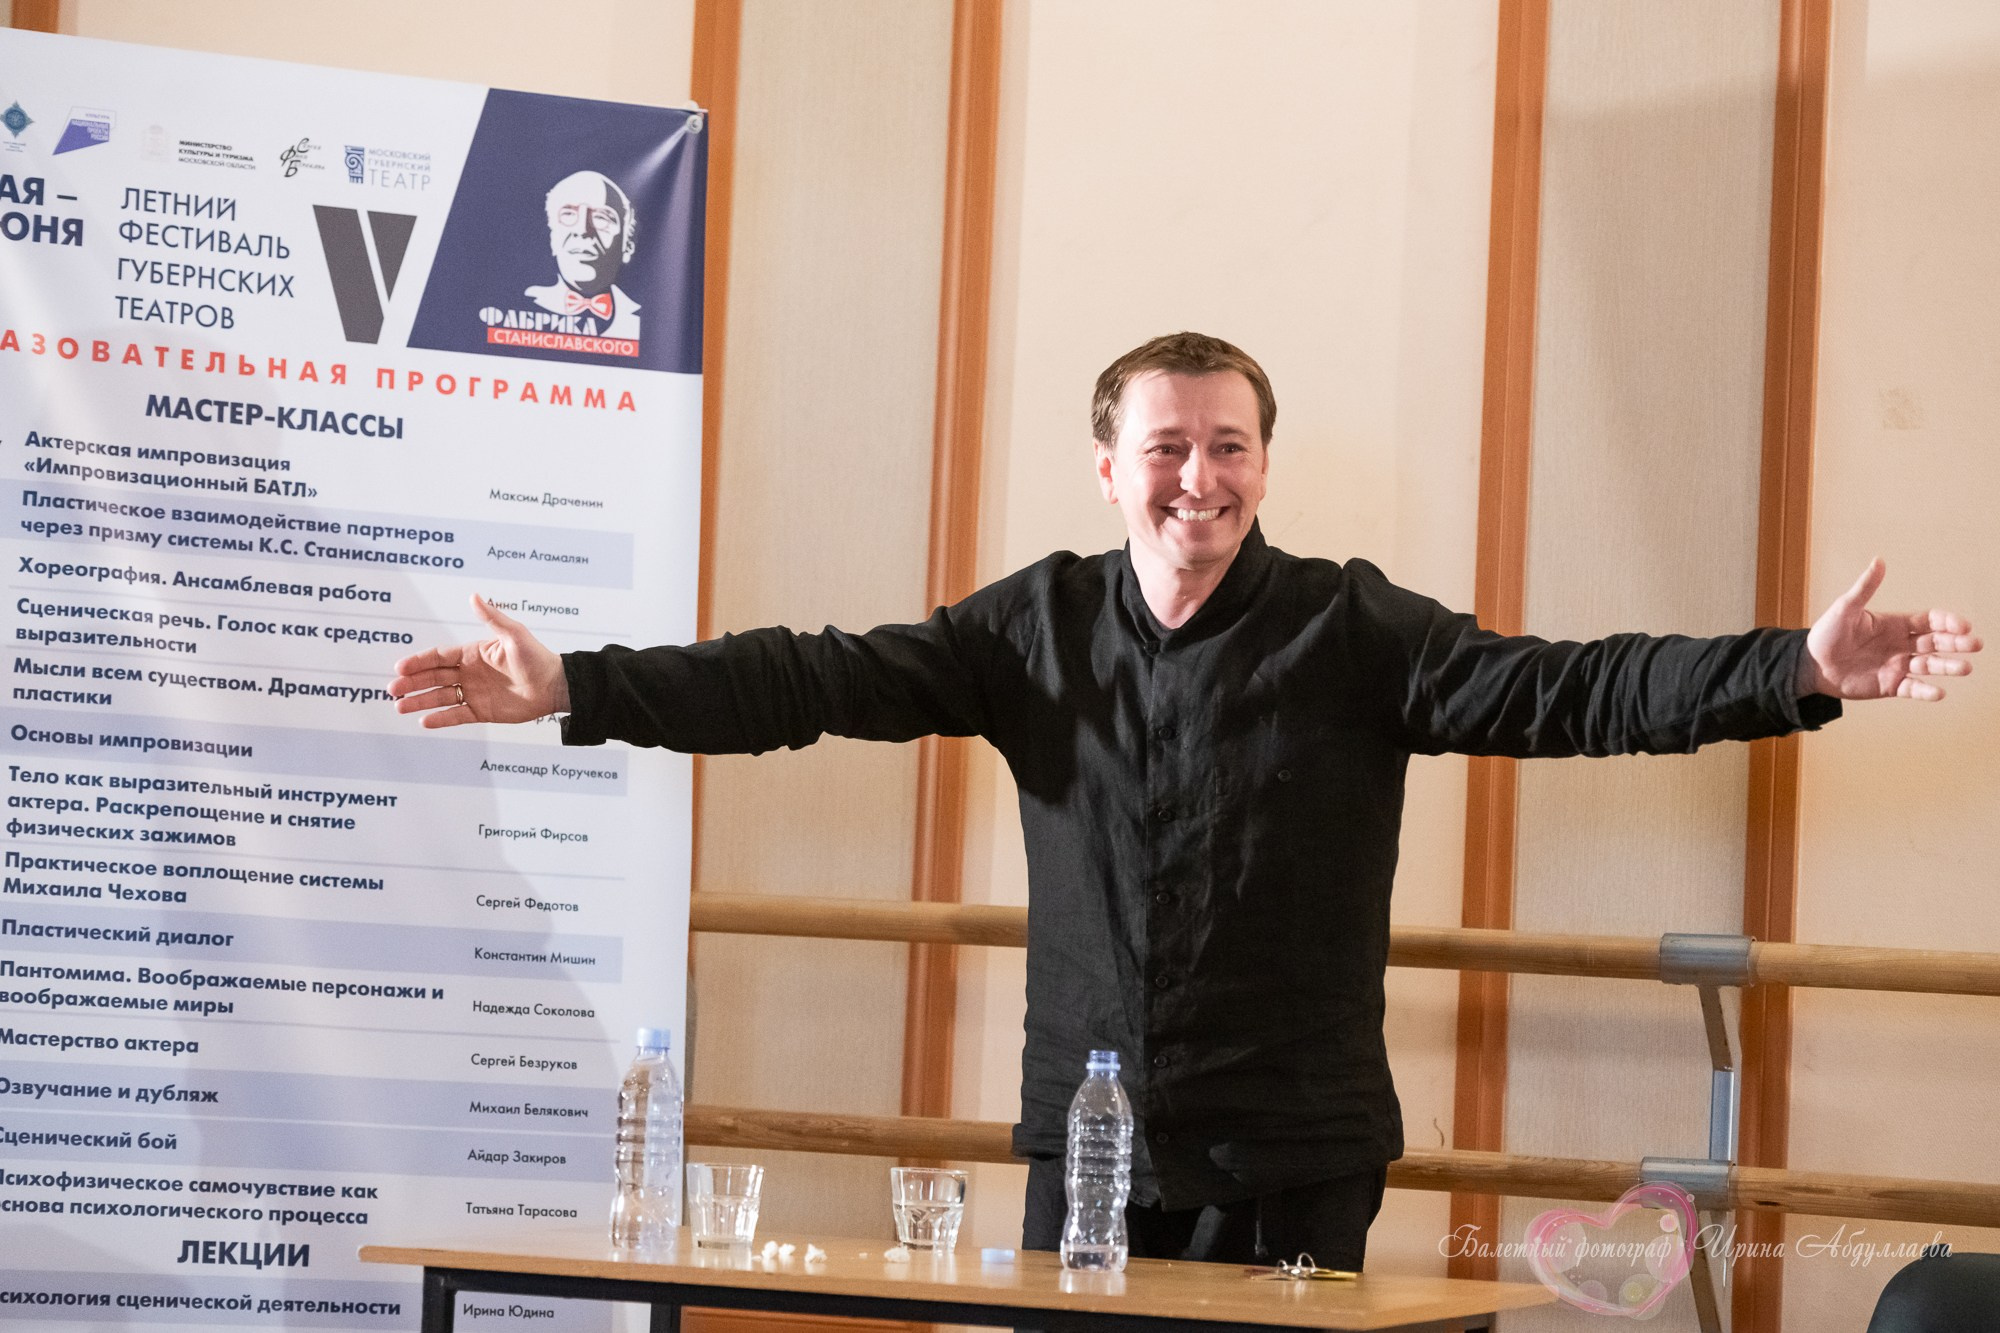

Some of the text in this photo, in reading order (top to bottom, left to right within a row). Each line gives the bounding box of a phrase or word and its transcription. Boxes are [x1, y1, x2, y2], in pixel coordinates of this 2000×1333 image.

[368, 158, 431, 172] ГУБЕРНСКИЙ
[369, 148, 431, 161] МОСКОВСКИЙ
[369, 168, 431, 191] ТЕАТР
[120, 187, 236, 221] ЛЕТНИЙ
[119, 219, 290, 259] ФЕСТИВАЛЬ
[118, 257, 294, 298] ГУБЕРНСКИХ
[313, 204, 417, 345] V
[115, 295, 234, 329] ТЕАТРОВ
[479, 306, 598, 337] ФАБРИКА
[493, 329, 634, 355] СТАНИСЛАВСКОГО
[377, 368, 636, 412] ПРОГРАММА
[145, 394, 403, 439] МАСТЕР-КЛАССЫ
[24, 431, 290, 472] Актерская импровизация
[24, 457, 318, 498] «Импровизационный БАТЛ»
[490, 489, 603, 508] Максим Драченин
[22, 490, 454, 545] Пластическое взаимодействие партнеров
[21, 520, 464, 569] через призму системы К.С. Станиславского
[487, 546, 588, 564] Арсен Агамалян
[18, 556, 391, 603] Хореография. Ансамблевая работа
[17, 597, 413, 644] Сценическая речь. Голос как средство
[487, 598, 579, 616] Анна Гилунова
[16, 628, 197, 654] выразительности
[13, 657, 405, 703] Мысли всем существом. Драматурги
[13, 688, 112, 705] пластики
[11, 724, 253, 758] Основы импровизации
[480, 759, 618, 780] Александр Коручеков
[8, 765, 398, 808] Тело как выразительный инструмент
[7, 796, 356, 830] актера. Раскрепощение и снятие
[6, 817, 236, 846] физических зажимов
[479, 824, 588, 843] Григорий Фирсов
[5, 851, 384, 890] Практическое воплощение системы
[3, 877, 187, 903] Михаила Чехова
[476, 894, 579, 912] Сергей Федотов
[2, 918, 234, 946] Пластический диалог
[475, 947, 596, 965] Константин Мишин
[0, 960, 444, 1000] Пантомима. Воображаемые персонажи и
[0, 988, 234, 1017] воображаемые миры
[473, 1000, 595, 1018] Надежда Соколова
[0, 1028, 199, 1057] Мастерство актера
[471, 1053, 577, 1072] Сергей Безруков
[118, 1087, 130, 1099] и
[135, 1084, 219, 1105] дубляж
[469, 1101, 588, 1117] Михаил Белякович
[137, 1132, 177, 1150] бой
[467, 1149, 566, 1166] Айдар Закиров
[189, 1180, 335, 1199] самочувствие
[341, 1186, 378, 1199] как
[0, 1199, 368, 1226] снова психологического процесса
[466, 1202, 577, 1219] Татьяна Тарасова
[177, 1240, 310, 1270] ЛЕКЦИИ
[116, 1294, 252, 1310] сценической
[257, 1299, 401, 1315] деятельности
[463, 1303, 554, 1319] Ирина Юдина
